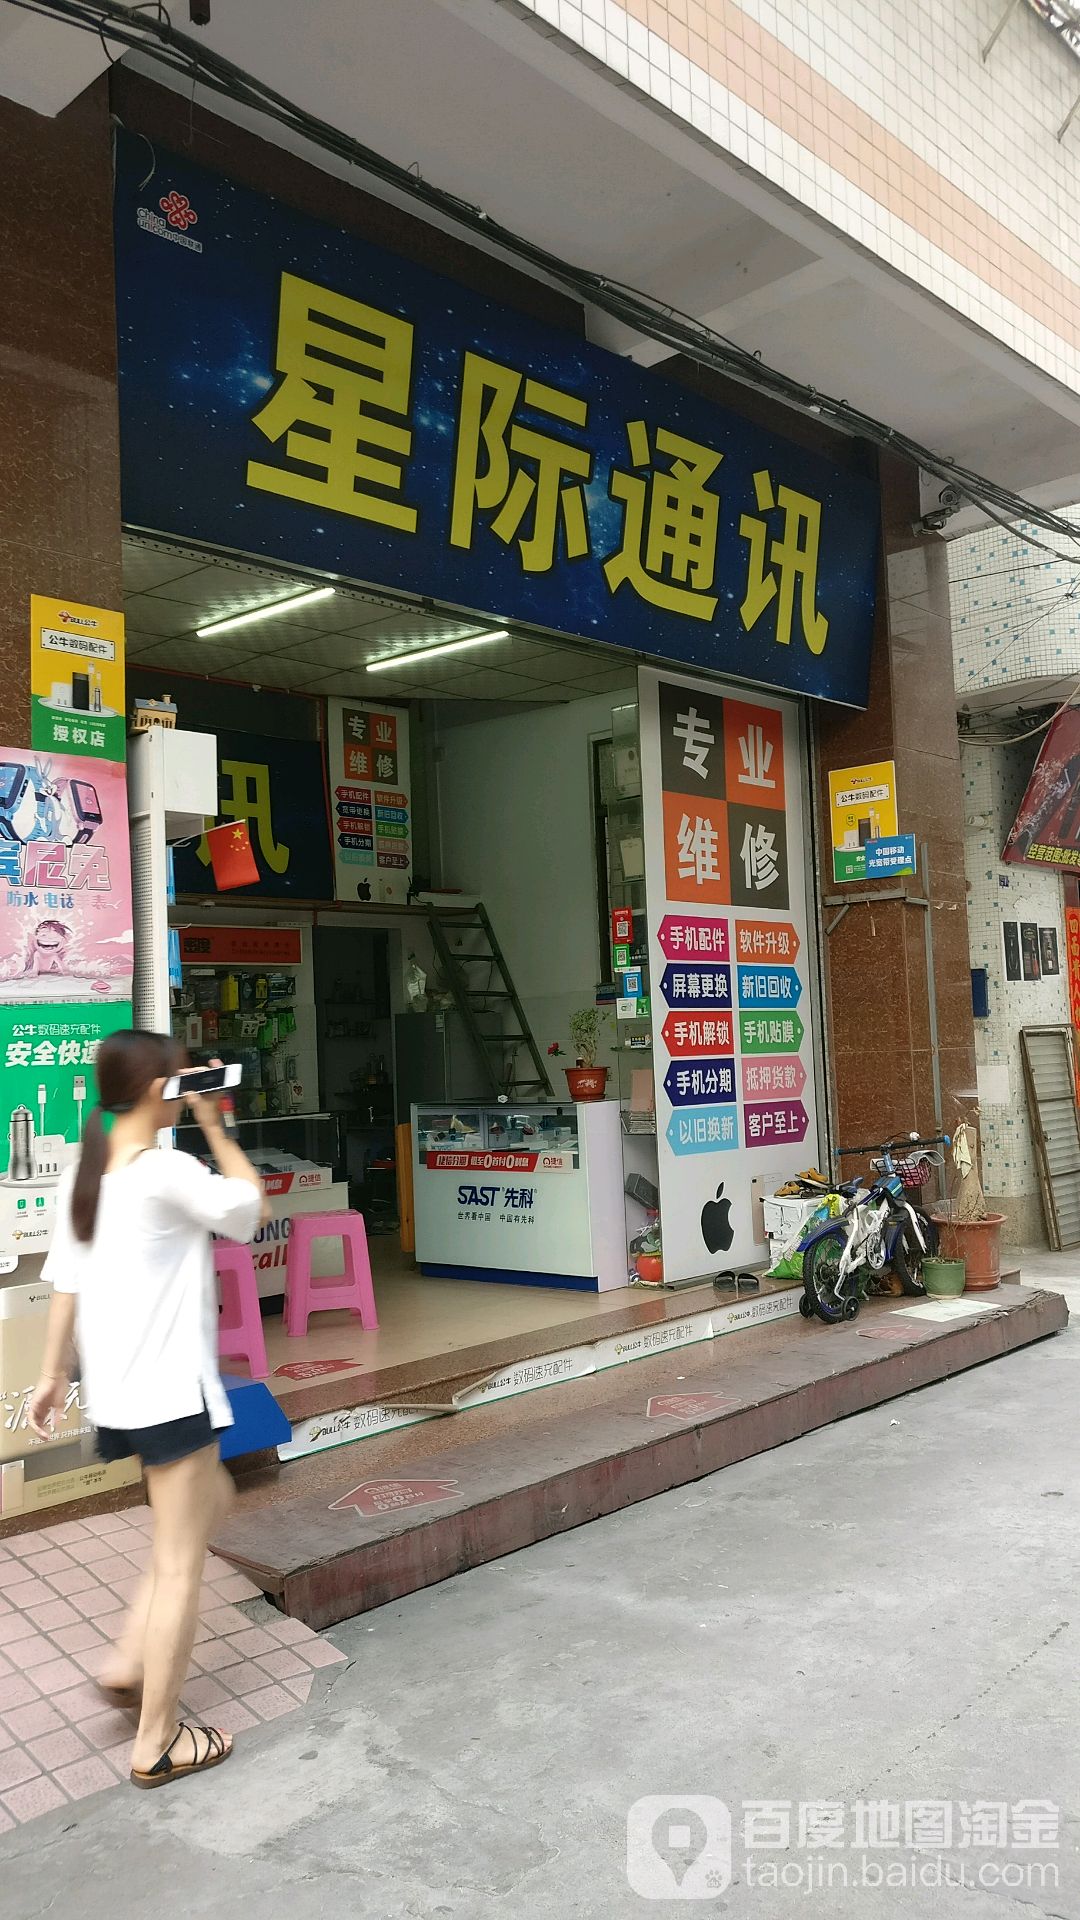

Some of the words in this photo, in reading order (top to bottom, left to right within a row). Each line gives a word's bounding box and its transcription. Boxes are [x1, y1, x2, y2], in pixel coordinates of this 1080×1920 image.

[246, 271, 829, 655] 星际通讯
[49, 634, 107, 655] 公牛数码配件
[53, 724, 105, 747] 授权店
[348, 716, 393, 744] 专业
[673, 707, 776, 788] 专业
[350, 750, 394, 778] 维修
[841, 789, 884, 803] 公牛数码配件
[677, 812, 780, 890] 维修
[875, 846, 905, 857] 中国移动
[670, 925, 726, 953] 手机配件
[739, 928, 790, 955] 软件升级
[672, 973, 729, 999] 屏幕更换
[742, 974, 793, 999] 新旧回收
[12, 1024, 101, 1037] 公牛数码速充配件
[674, 1020, 730, 1046] 手机解锁
[743, 1020, 795, 1044] 手机贴膜
[676, 1068, 732, 1096] 手机分期
[746, 1065, 797, 1091] 抵押货款
[679, 1115, 734, 1145] 以旧换新
[748, 1110, 800, 1137] 客户至上
[457, 1186, 500, 1206] SAST
[504, 1188, 534, 1208] 先科
[457, 1212, 491, 1222] 世界看中国
[500, 1214, 535, 1224] 中国有先科
[752, 1296, 793, 1318] 数码速充配件
[644, 1323, 693, 1348] 数码速充配件
[514, 1358, 573, 1386] 数码速充配件
[354, 1407, 419, 1430] 数码速充配
